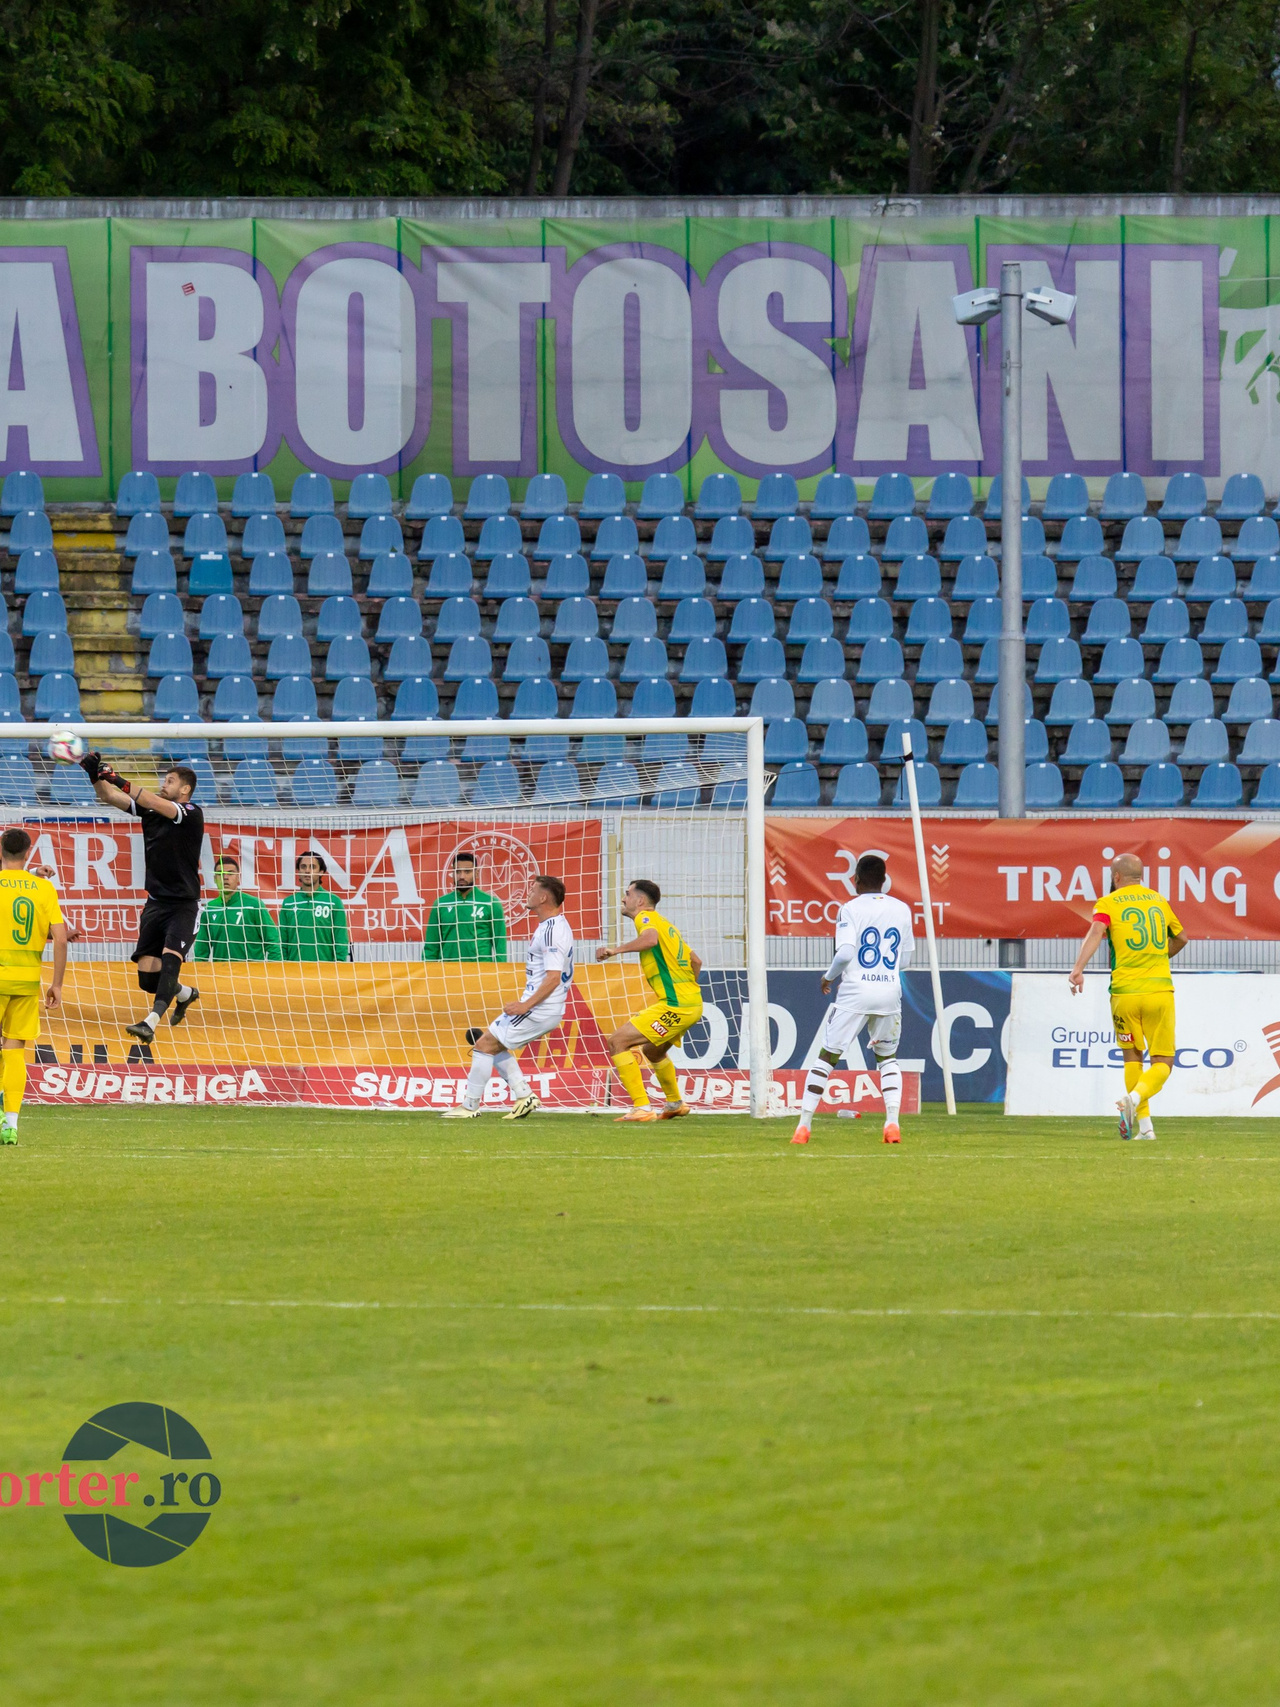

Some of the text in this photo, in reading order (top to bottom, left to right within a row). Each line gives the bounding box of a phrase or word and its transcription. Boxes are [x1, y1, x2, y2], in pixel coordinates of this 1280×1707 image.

[144, 256, 1205, 466] BOTOSANI
[0, 878, 39, 891] GUTEA
[11, 895, 35, 946] 9
[235, 911, 244, 926] 7
[314, 904, 330, 919] 80
[470, 905, 485, 919] 14
[1120, 905, 1166, 951] 30
[857, 926, 901, 970] 83
[659, 1014, 674, 1028] DIN
[665, 1010, 682, 1025] APA
[650, 1020, 668, 1037] NOY
[1051, 1026, 1117, 1047] Grupul
[1051, 1047, 1235, 1069] ELSCO
[38, 1066, 269, 1102] SUPERLIGA
[646, 1072, 883, 1108] SUPELGA
